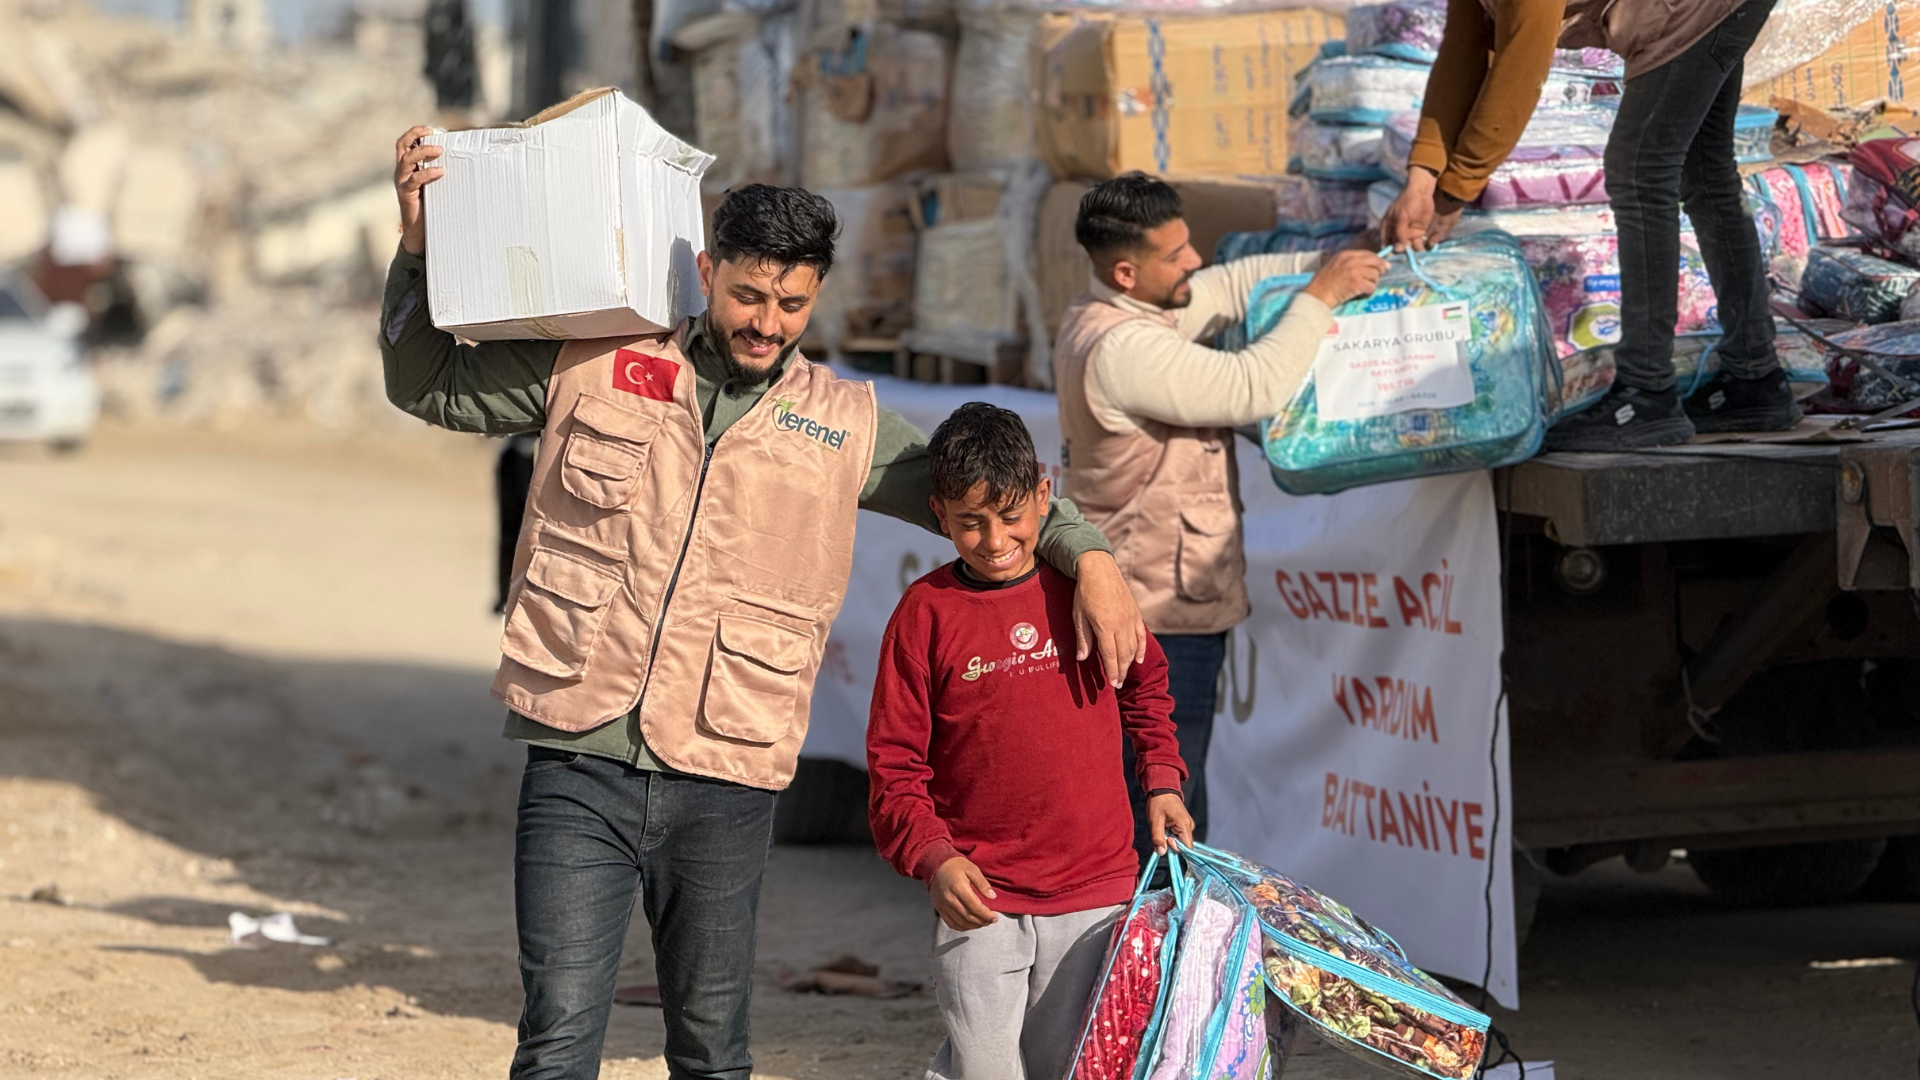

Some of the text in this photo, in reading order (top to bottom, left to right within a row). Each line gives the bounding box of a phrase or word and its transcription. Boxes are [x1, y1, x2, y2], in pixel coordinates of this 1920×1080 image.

[1333, 330, 1456, 353] SAKARYA GRUBU
[1275, 558, 1462, 635] GAZZE ACİL
[1321, 771, 1485, 860] BATTANİYE
